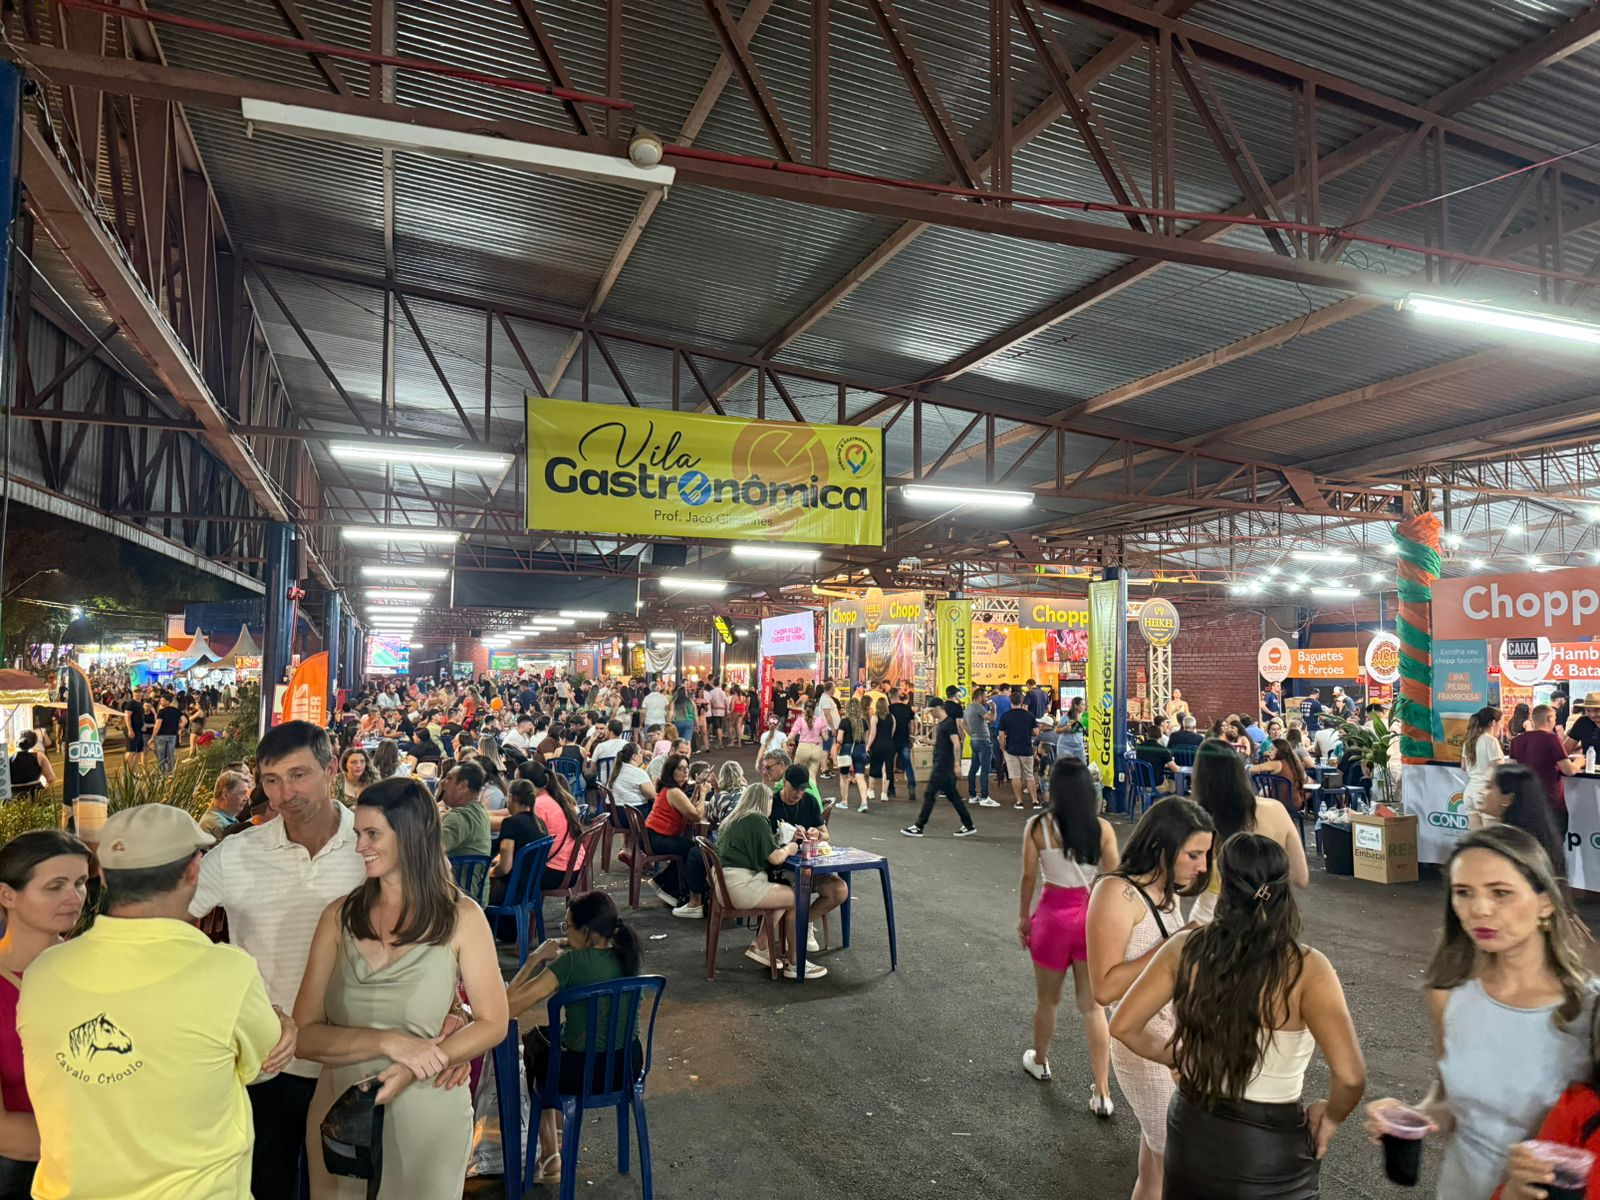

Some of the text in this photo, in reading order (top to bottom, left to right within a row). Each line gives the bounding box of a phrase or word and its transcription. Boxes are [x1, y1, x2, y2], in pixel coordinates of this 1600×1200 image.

[578, 420, 700, 470] Vila
[544, 456, 868, 511] Gastronômica
[654, 509, 682, 522] Prof.
[686, 511, 713, 524] Jacó
[889, 600, 921, 622] Chopp
[1462, 582, 1600, 627] Chopp
[832, 607, 857, 627] Chopp
[1032, 604, 1088, 628] Chopp
[1297, 651, 1344, 665] Baguetes
[1508, 642, 1536, 656] CAIXA
[1552, 646, 1600, 661] Hamb
[1298, 665, 1344, 676] & Porções
[1552, 663, 1600, 677] & Bata
[1428, 812, 1468, 829] COND
[55, 1052, 143, 1084] Cavalo Crioulo
